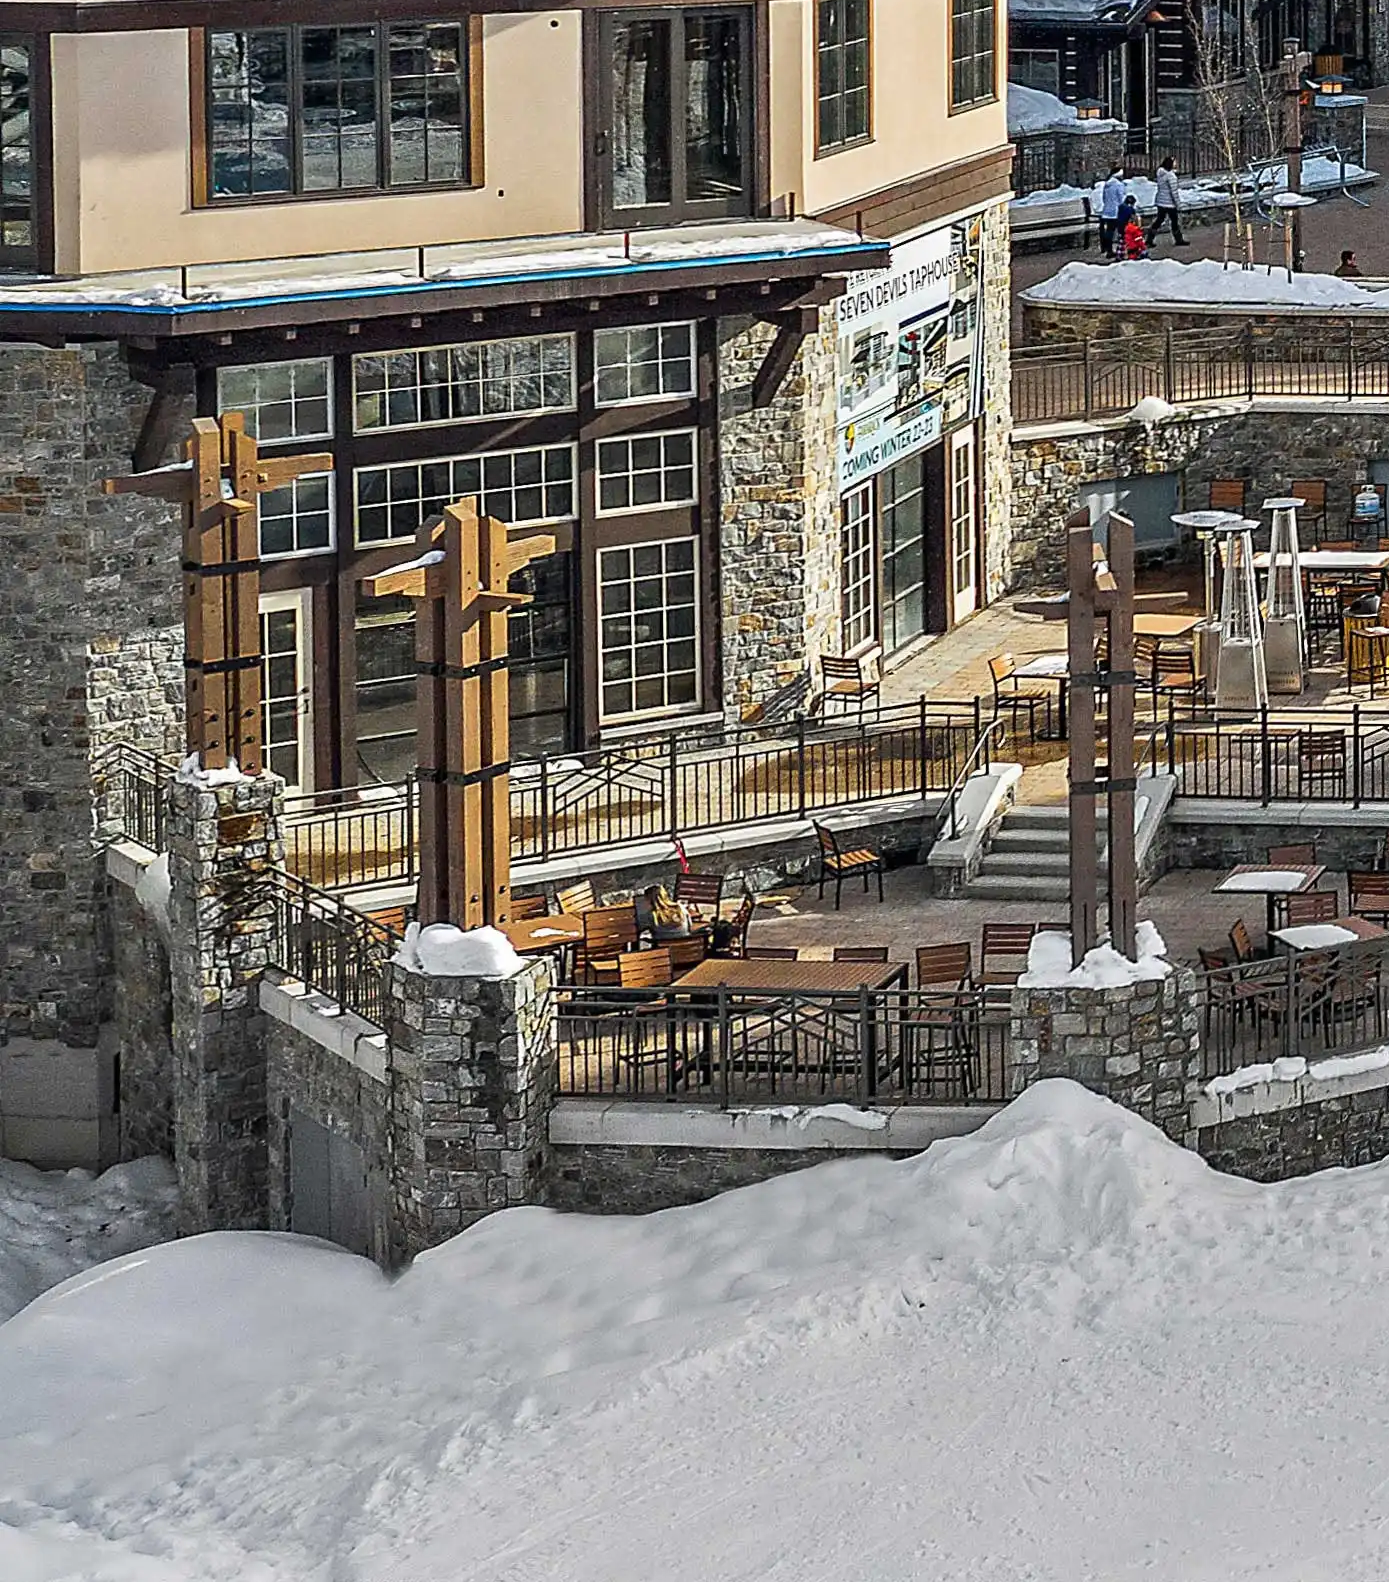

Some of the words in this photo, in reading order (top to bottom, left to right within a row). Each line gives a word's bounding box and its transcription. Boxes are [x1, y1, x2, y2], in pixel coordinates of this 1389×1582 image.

[839, 287, 875, 322] SEVEN
[876, 273, 908, 308] DEVILS
[909, 251, 961, 292] TAPHOUSE
[842, 445, 880, 480] COMING
[881, 428, 912, 459] WINTER
[912, 416, 934, 443] 22-23
